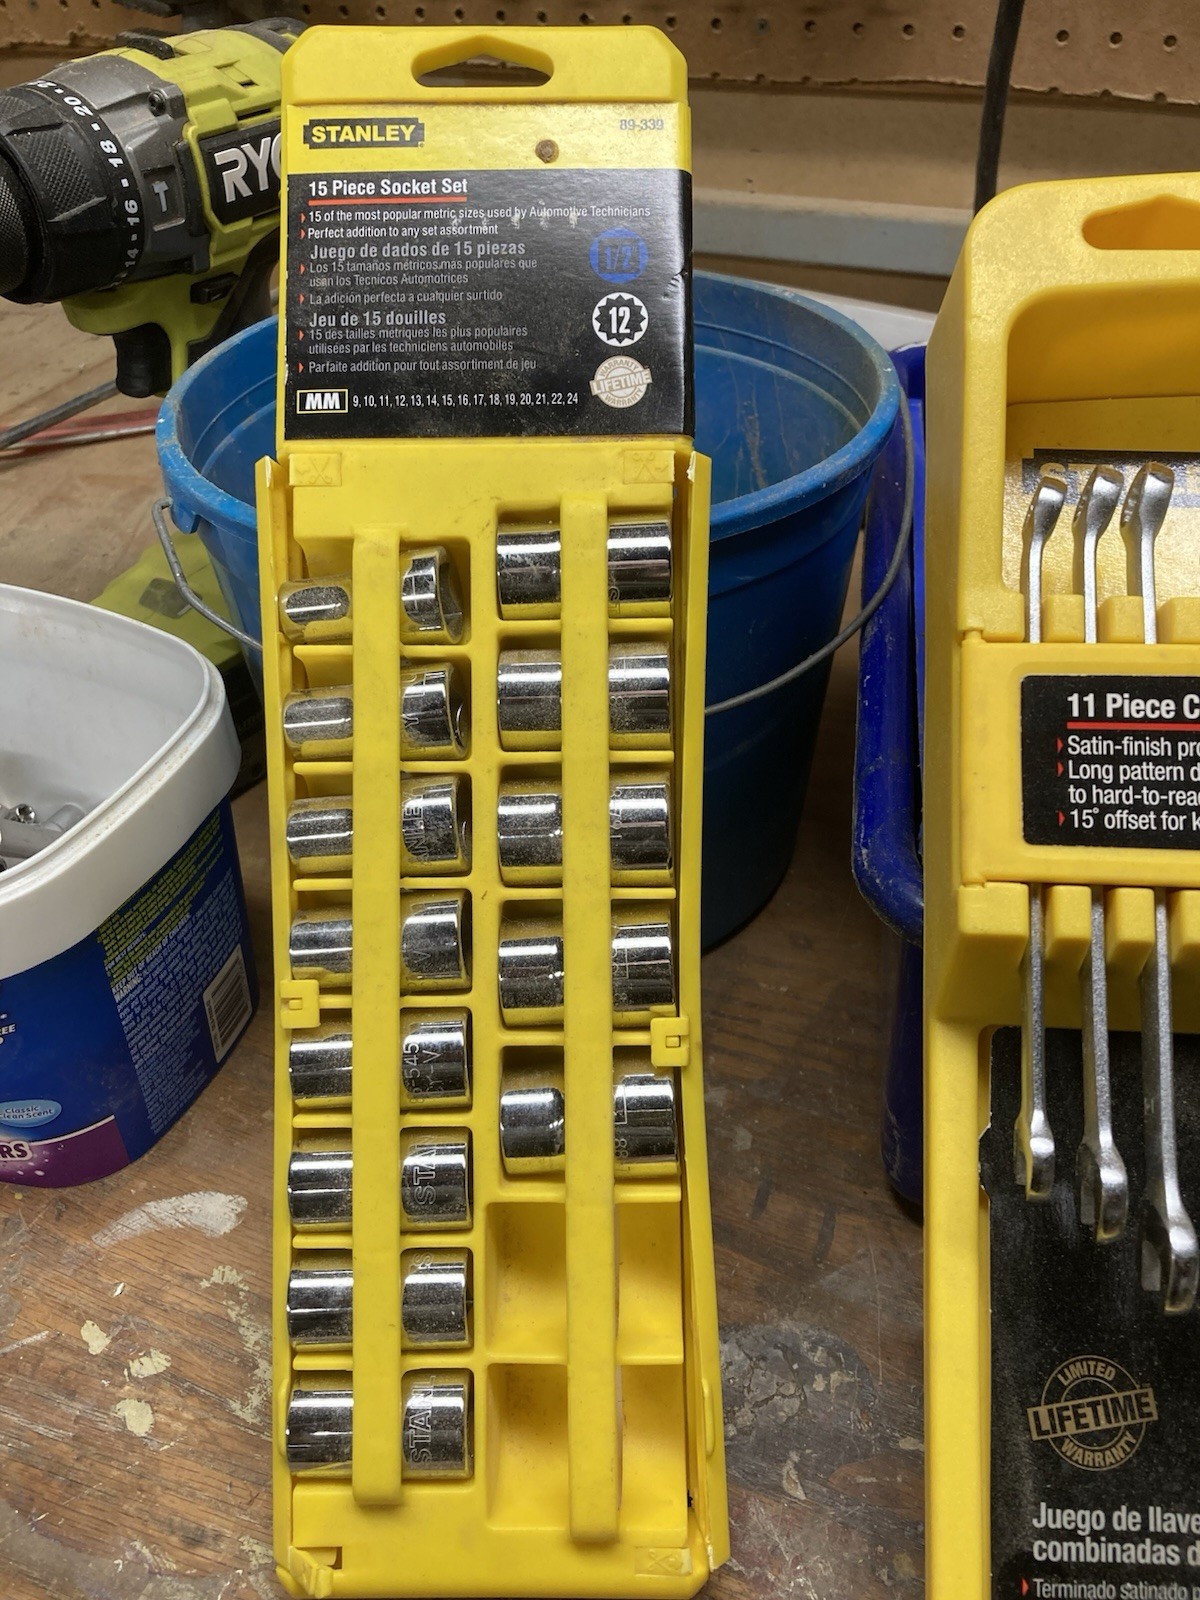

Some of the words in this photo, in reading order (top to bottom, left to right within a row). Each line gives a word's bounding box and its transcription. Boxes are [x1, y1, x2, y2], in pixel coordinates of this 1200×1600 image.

[64, 96, 93, 116] 20
[312, 125, 416, 142] STANLEY
[620, 119, 664, 132] 89-339
[100, 140, 124, 168] 18
[309, 181, 327, 196] 15
[332, 180, 375, 195] Piece
[380, 178, 437, 195] Socket
[442, 178, 468, 194] Set
[124, 199, 140, 226] 16
[309, 211, 321, 222] 15
[324, 210, 335, 222] of
[337, 209, 352, 221] the
[355, 209, 380, 221] most
[383, 208, 421, 222] popular
[424, 208, 456, 219] metric
[459, 208, 484, 219] sizes
[487, 207, 512, 218] used
[514, 206, 526, 219] by
[530, 206, 588, 217] Automotive
[590, 205, 651, 217] Technicians
[308, 227, 344, 239] Perfect
[346, 227, 387, 238] addition
[389, 227, 399, 237] to
[401, 228, 419, 239] any
[422, 225, 438, 236] set
[440, 225, 498, 235] assortment
[311, 244, 356, 261] Juego
[360, 243, 377, 258] de
[382, 242, 427, 257] dados
[432, 242, 449, 256] de
[455, 241, 472, 256] 15
[477, 241, 526, 258] piezas
[310, 262, 328, 273] Los
[332, 261, 344, 272] 15
[346, 259, 390, 272] tamaños
[465, 257, 516, 271] populares
[518, 258, 538, 270] que
[336, 275, 351, 286] los
[401, 273, 469, 284] Automotrices
[310, 294, 322, 305] La
[364, 291, 406, 305] perfecta
[408, 293, 414, 302] a
[416, 290, 464, 304] cualquier
[467, 289, 503, 301] surtido
[309, 312, 336, 328] Jeu
[340, 312, 359, 327] de
[363, 311, 382, 326] 15
[385, 310, 446, 325] douilles
[609, 306, 631, 334] 12
[309, 329, 323, 340] 15
[325, 328, 343, 340] des
[345, 328, 376, 339] tailles
[432, 327, 448, 338] les
[450, 326, 472, 339] plus
[474, 325, 528, 339] populaires
[353, 343, 370, 355] par
[372, 341, 387, 353] les
[389, 340, 448, 352] techniciens
[451, 340, 513, 351] automobiles
[308, 361, 348, 373] Parfaite
[350, 359, 391, 372] addition
[393, 361, 417, 373] pour
[419, 359, 440, 371] tout
[442, 358, 503, 371] assortiment
[506, 358, 518, 370] de
[521, 358, 536, 372] jeu
[592, 370, 651, 395] LIFETIME
[305, 392, 341, 410] MM
[1067, 693, 1095, 718] 11
[1106, 693, 1176, 719] Piece
[1067, 735, 1171, 757] Satin-finish
[1068, 759, 1113, 784] Long
[1119, 762, 1184, 784] pattern
[1068, 785, 1087, 804] to
[1092, 784, 1200, 807] hard-to-rea
[1104, 809, 1157, 830] offset
[1161, 810, 1187, 831] for
[5, 1105, 39, 1114] Classic
[26, 1109, 52, 1118] Scent
[1057, 1360, 1116, 1386] LIMITED
[1033, 1391, 1154, 1437] LIFETIME
[1061, 1430, 1138, 1467] WARRANTY
[1032, 1502, 1105, 1536] Juego
[1112, 1505, 1142, 1532] de
[1033, 1537, 1180, 1566] combinadas
[1033, 1578, 1116, 1600] Terminado
[1120, 1581, 1188, 1600] satinado
